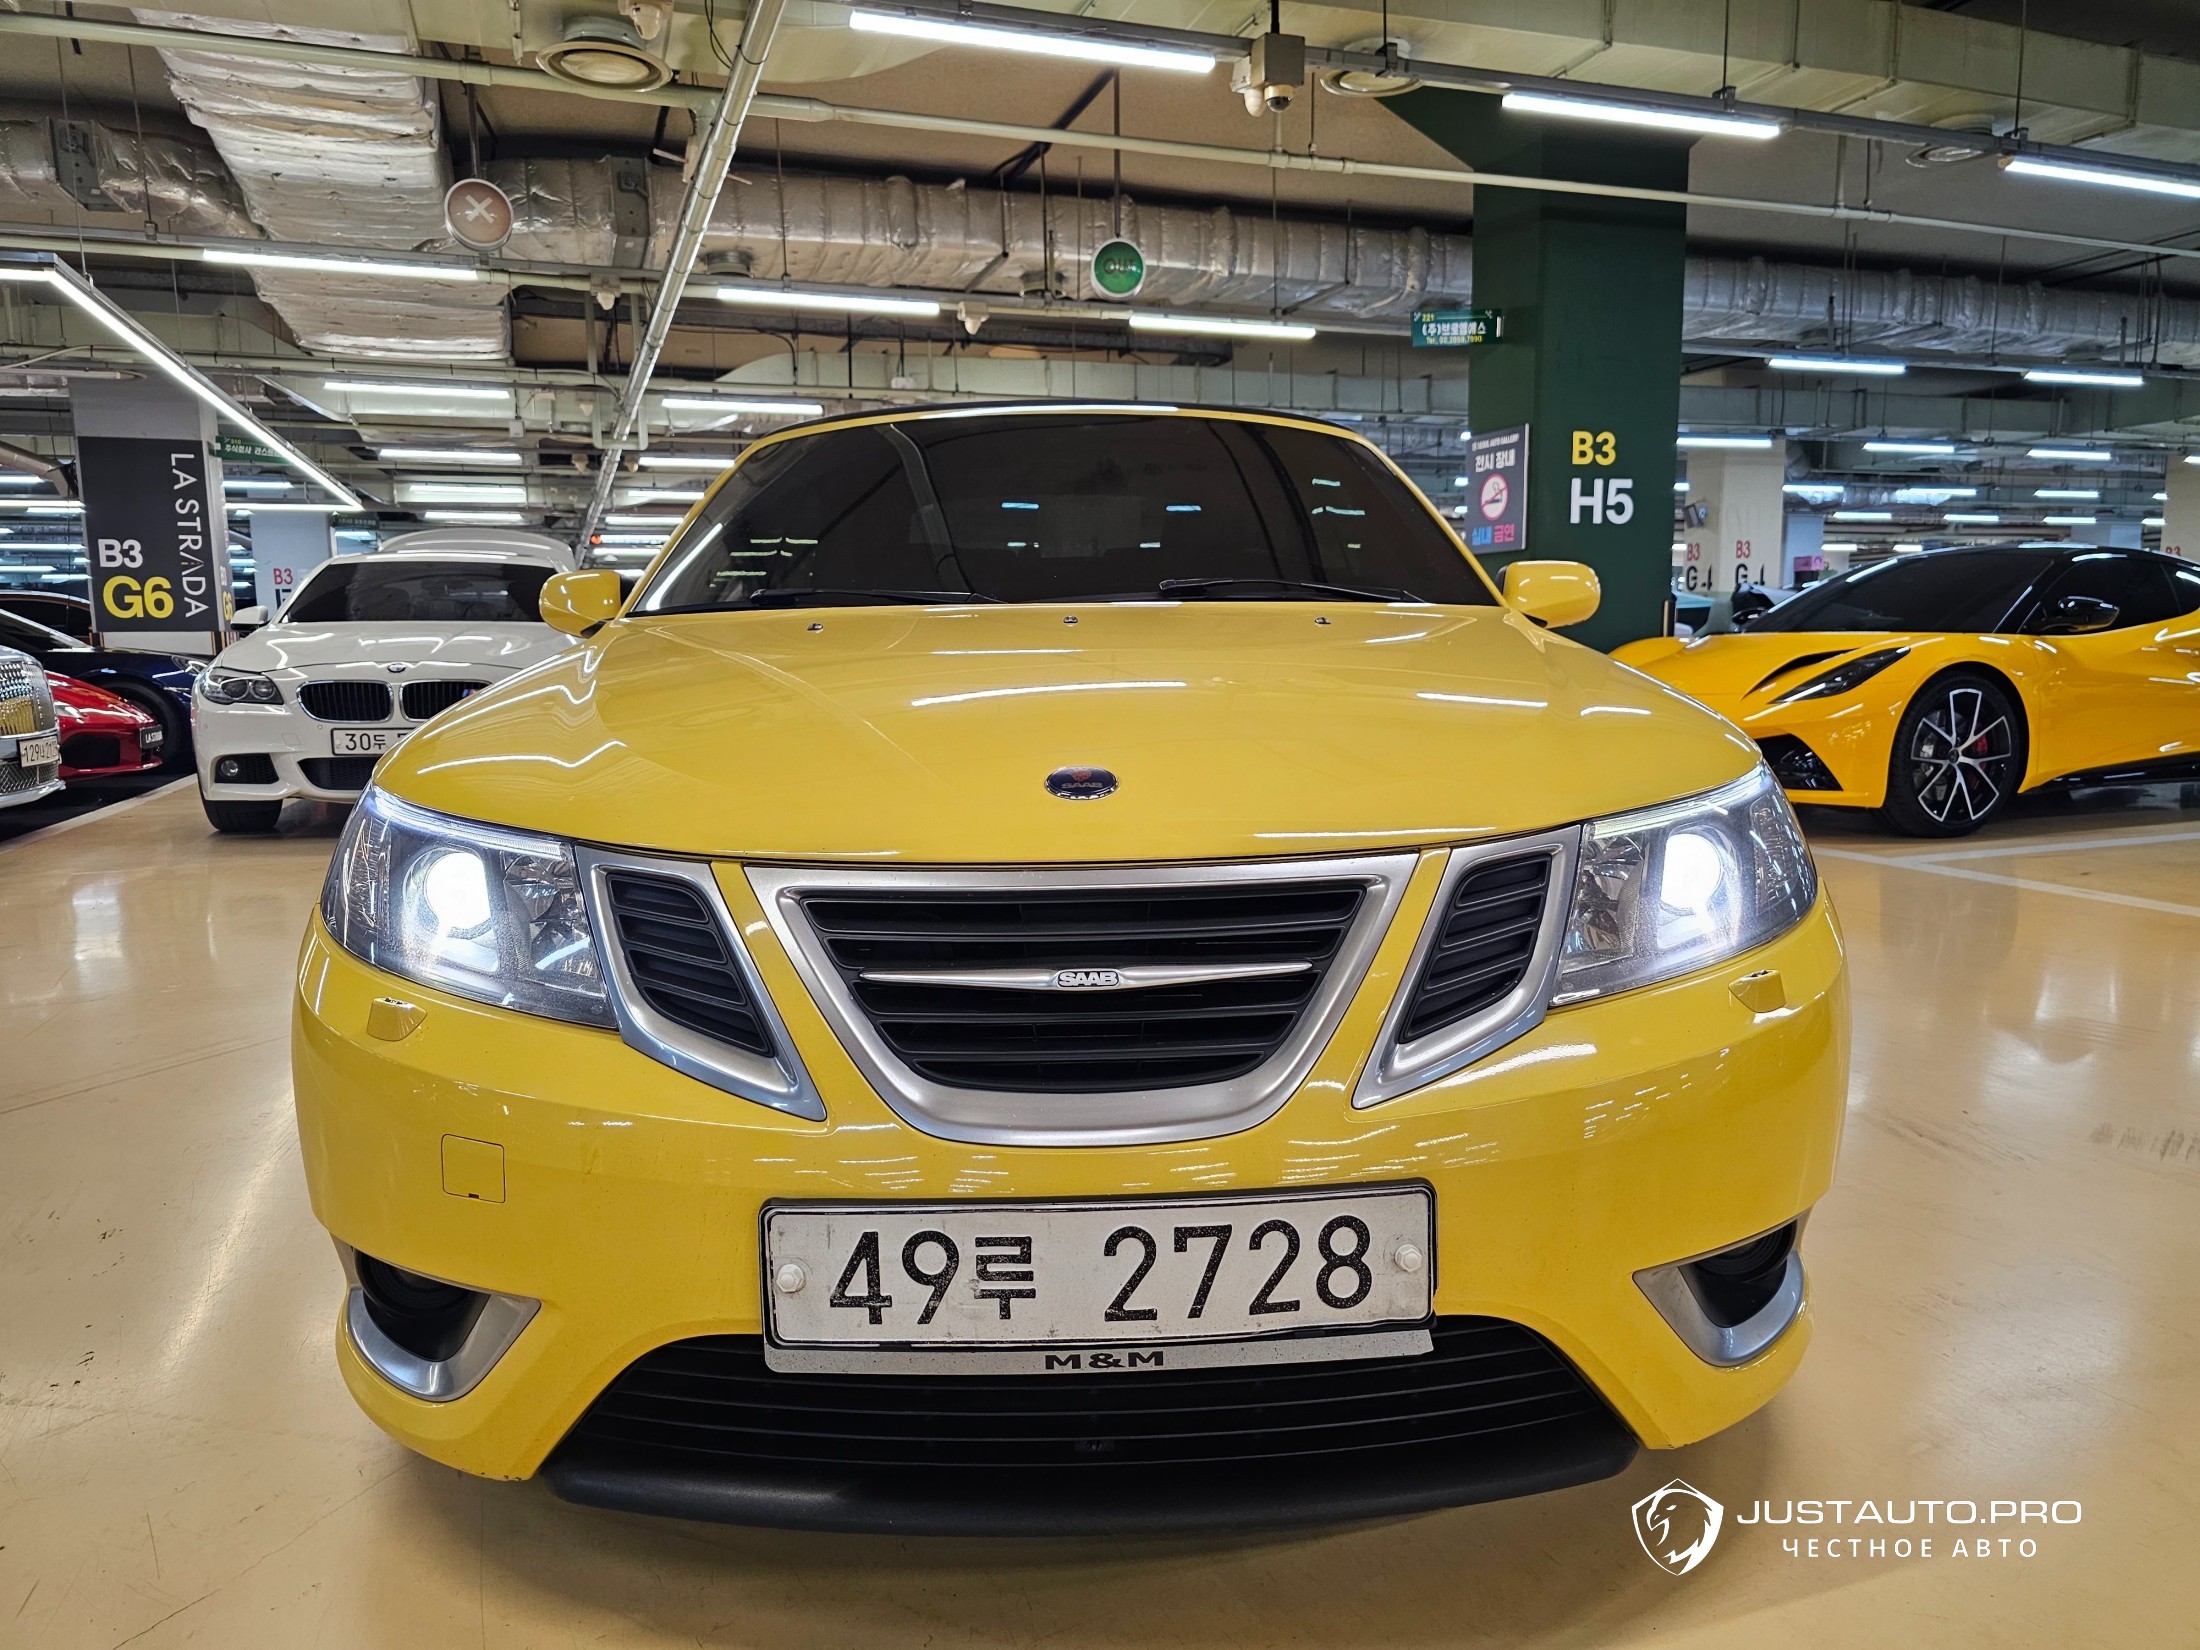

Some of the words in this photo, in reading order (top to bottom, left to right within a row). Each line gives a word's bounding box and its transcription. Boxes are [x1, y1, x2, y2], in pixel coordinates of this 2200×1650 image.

[1572, 431, 1616, 465] B3
[171, 453, 198, 490] LA
[1475, 453, 1495, 472] 전시
[1570, 478, 1634, 524] H5
[1494, 523, 1516, 543] 금연
[98, 538, 143, 568] B3
[175, 498, 209, 618] STRADA
[1687, 543, 1700, 561] B3
[1736, 540, 1751, 558] B3
[273, 568, 293, 585] B3
[103, 575, 174, 619] G6
[345, 733, 387, 751] 30두
[1058, 971, 1118, 987] SAAB
[829, 1229, 1036, 1325] 49루
[1103, 1215, 1373, 1323] 2728
[1045, 1350, 1163, 1370] M&M
